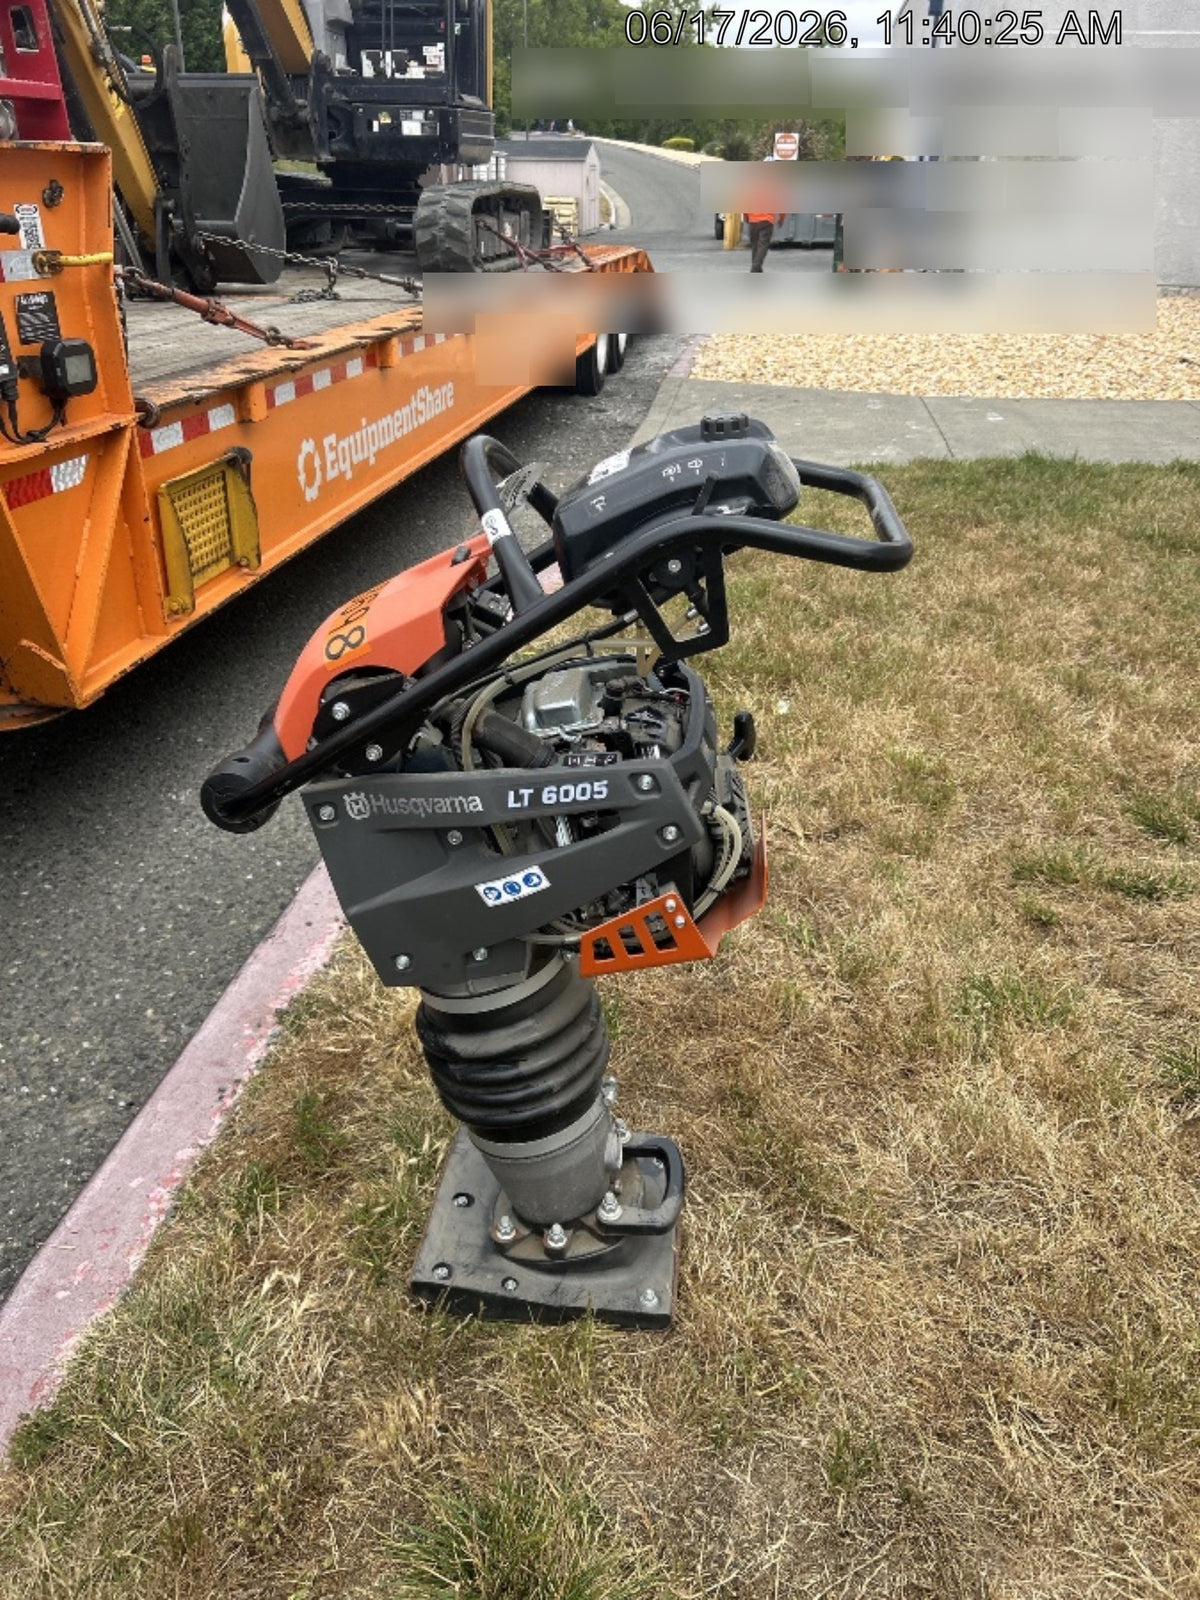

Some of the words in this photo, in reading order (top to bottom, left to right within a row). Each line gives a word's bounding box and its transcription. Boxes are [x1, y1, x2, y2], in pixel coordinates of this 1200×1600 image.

[323, 382, 454, 481] EquipmentShare
[369, 794, 484, 818] Husqvarna
[507, 789, 534, 808] LT
[541, 780, 609, 805] 6005
